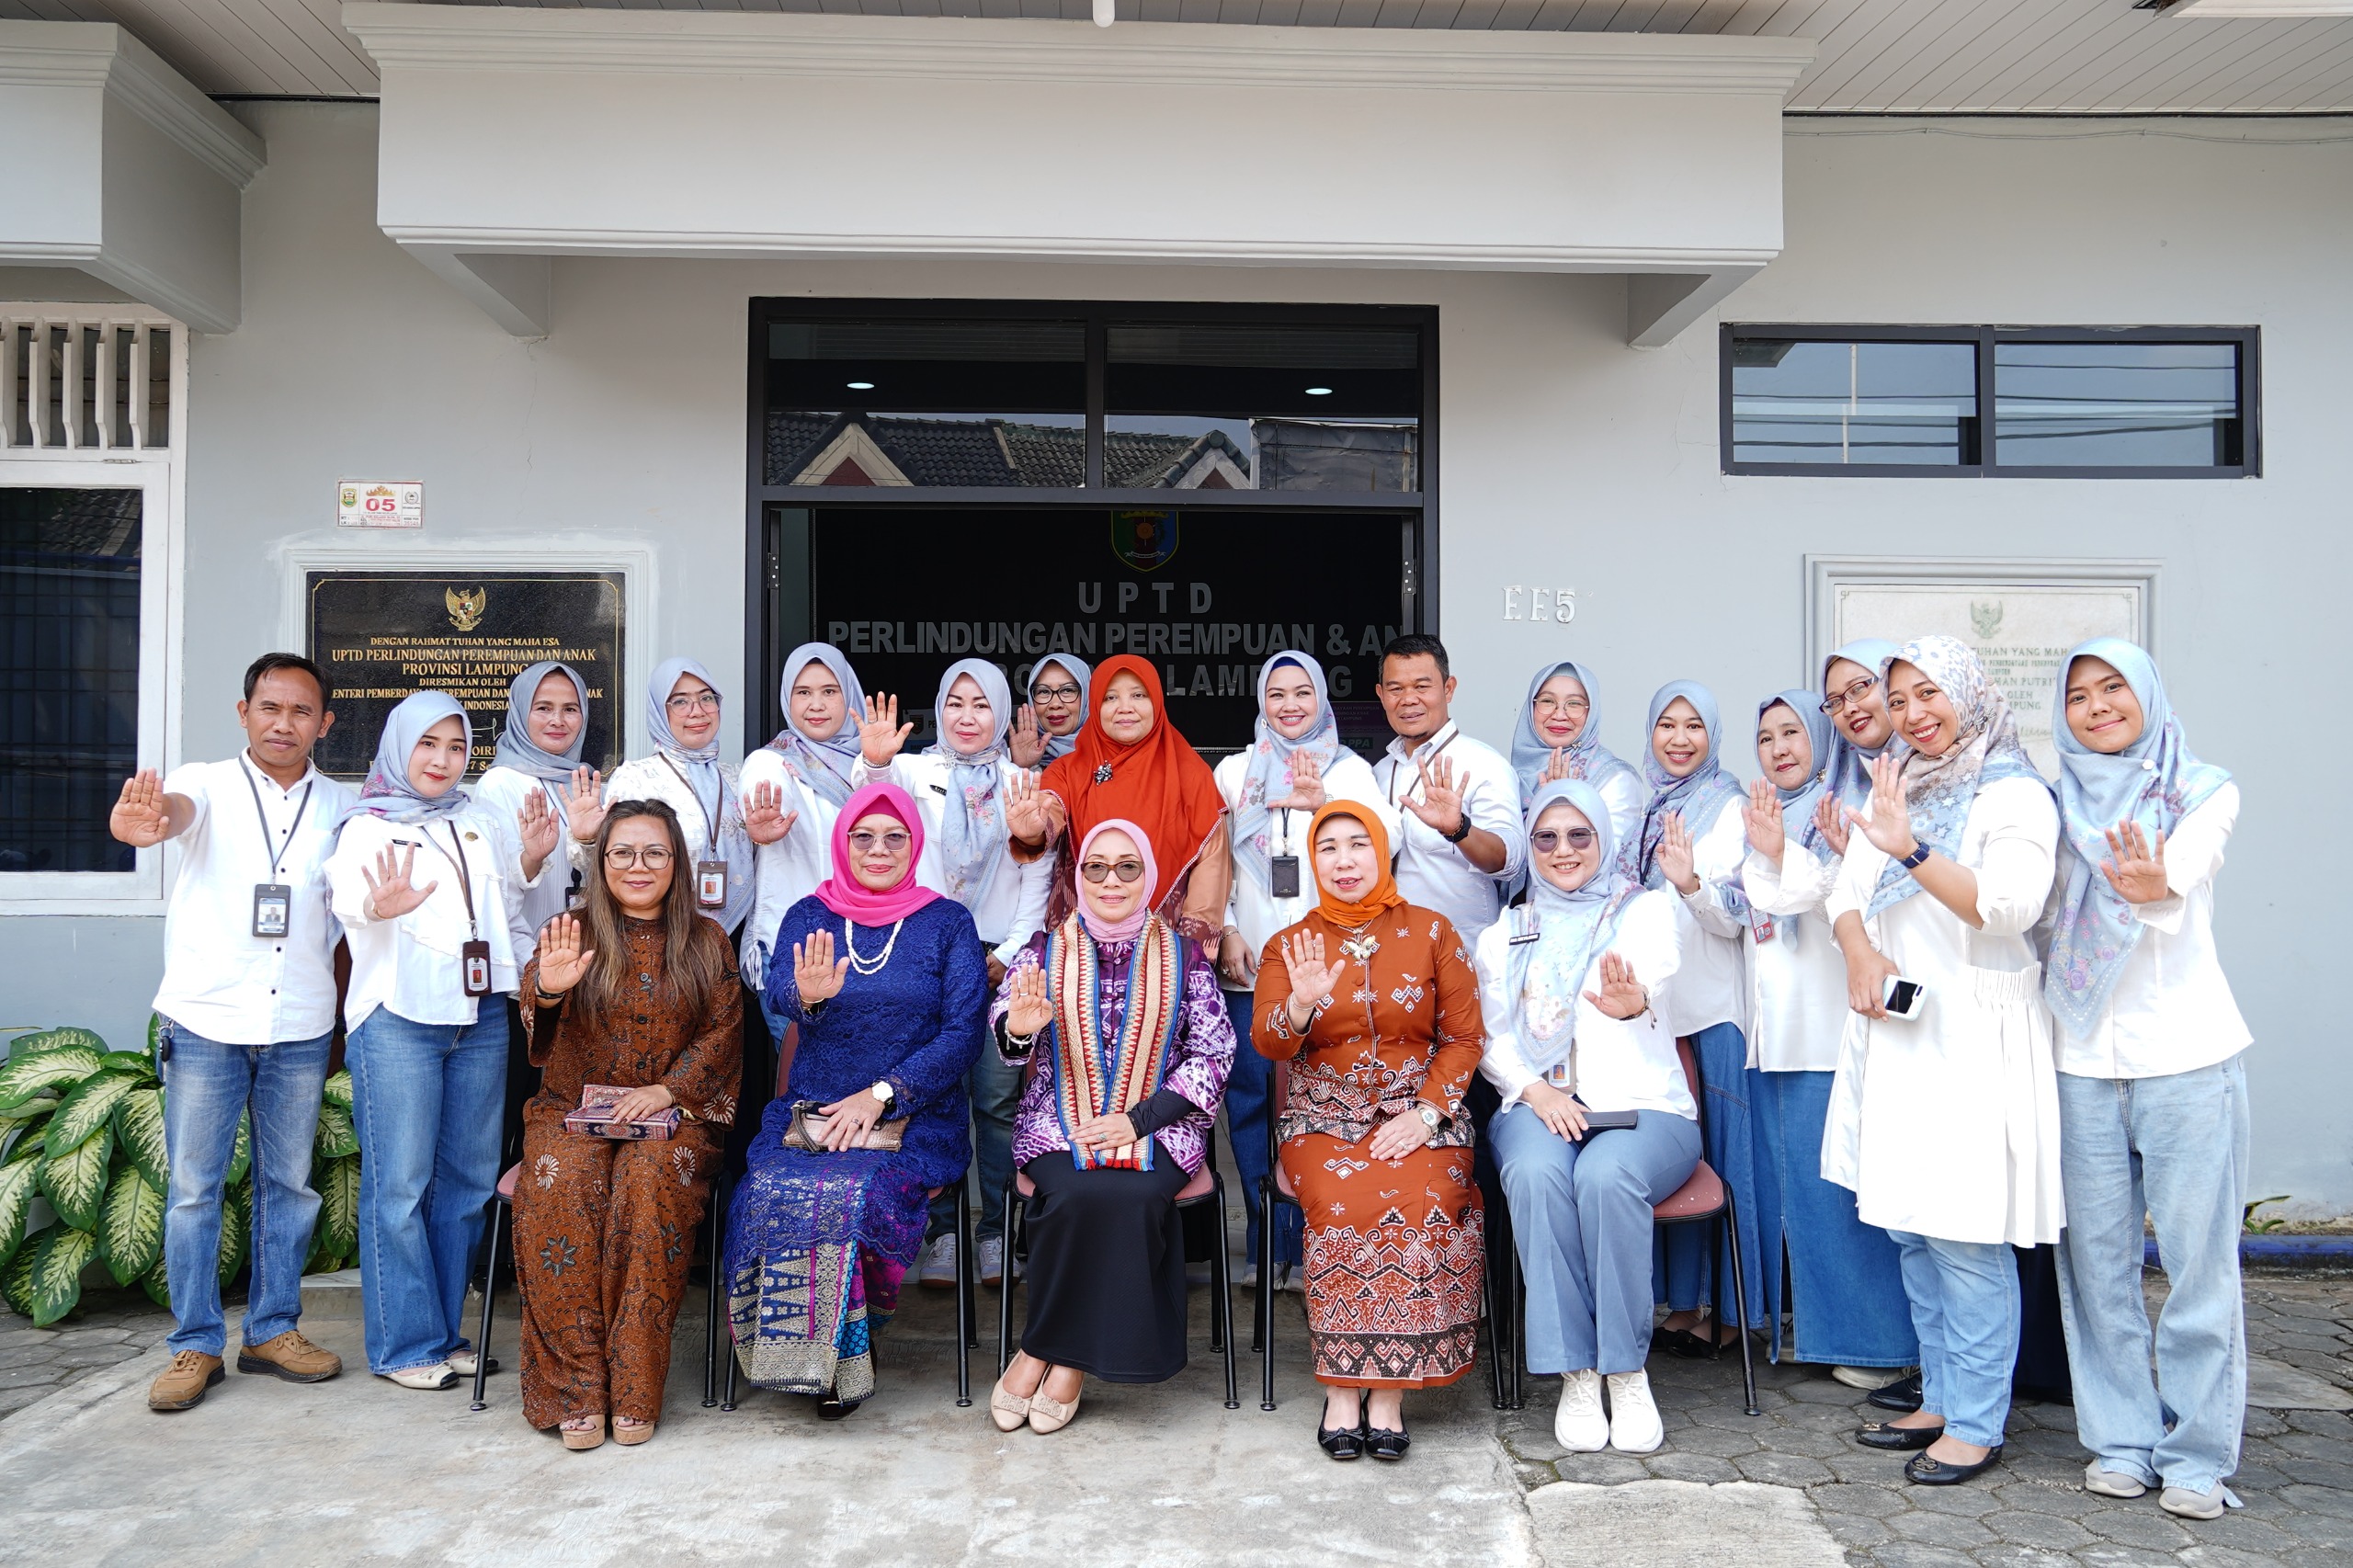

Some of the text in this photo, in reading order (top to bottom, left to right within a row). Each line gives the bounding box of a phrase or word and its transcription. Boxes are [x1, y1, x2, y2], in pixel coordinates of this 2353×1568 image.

[366, 498, 395, 512] 05
[1502, 585, 1575, 623] EE5
[370, 637, 560, 646] DENGAN RAHMAT TUHAN YANG MAHA ESA
[828, 621, 1097, 654] PERLINDUNGAN
[1105, 622, 1314, 655] PEREMPUAN
[1326, 623, 1351, 655] &
[332, 648, 597, 662] UPTD PERLINDUNGAN PEREMPUAN DAN ANAK
[2011, 647, 2040, 656] YANG
[2044, 647, 2068, 656] MAH
[403, 663, 461, 676] PROVINSI
[419, 677, 506, 687] DIRESMIKAN OLEH
[1166, 665, 1352, 698] LAMG
[333, 688, 365, 699] ENTERI
[367, 688, 438, 699] PEMBERDAY
[492, 688, 510, 699] DAN
[587, 688, 603, 699] NAK
[2007, 691, 2033, 699] OLEH
[464, 700, 509, 710] INDONESIA
[2009, 701, 2041, 710] PUNG
